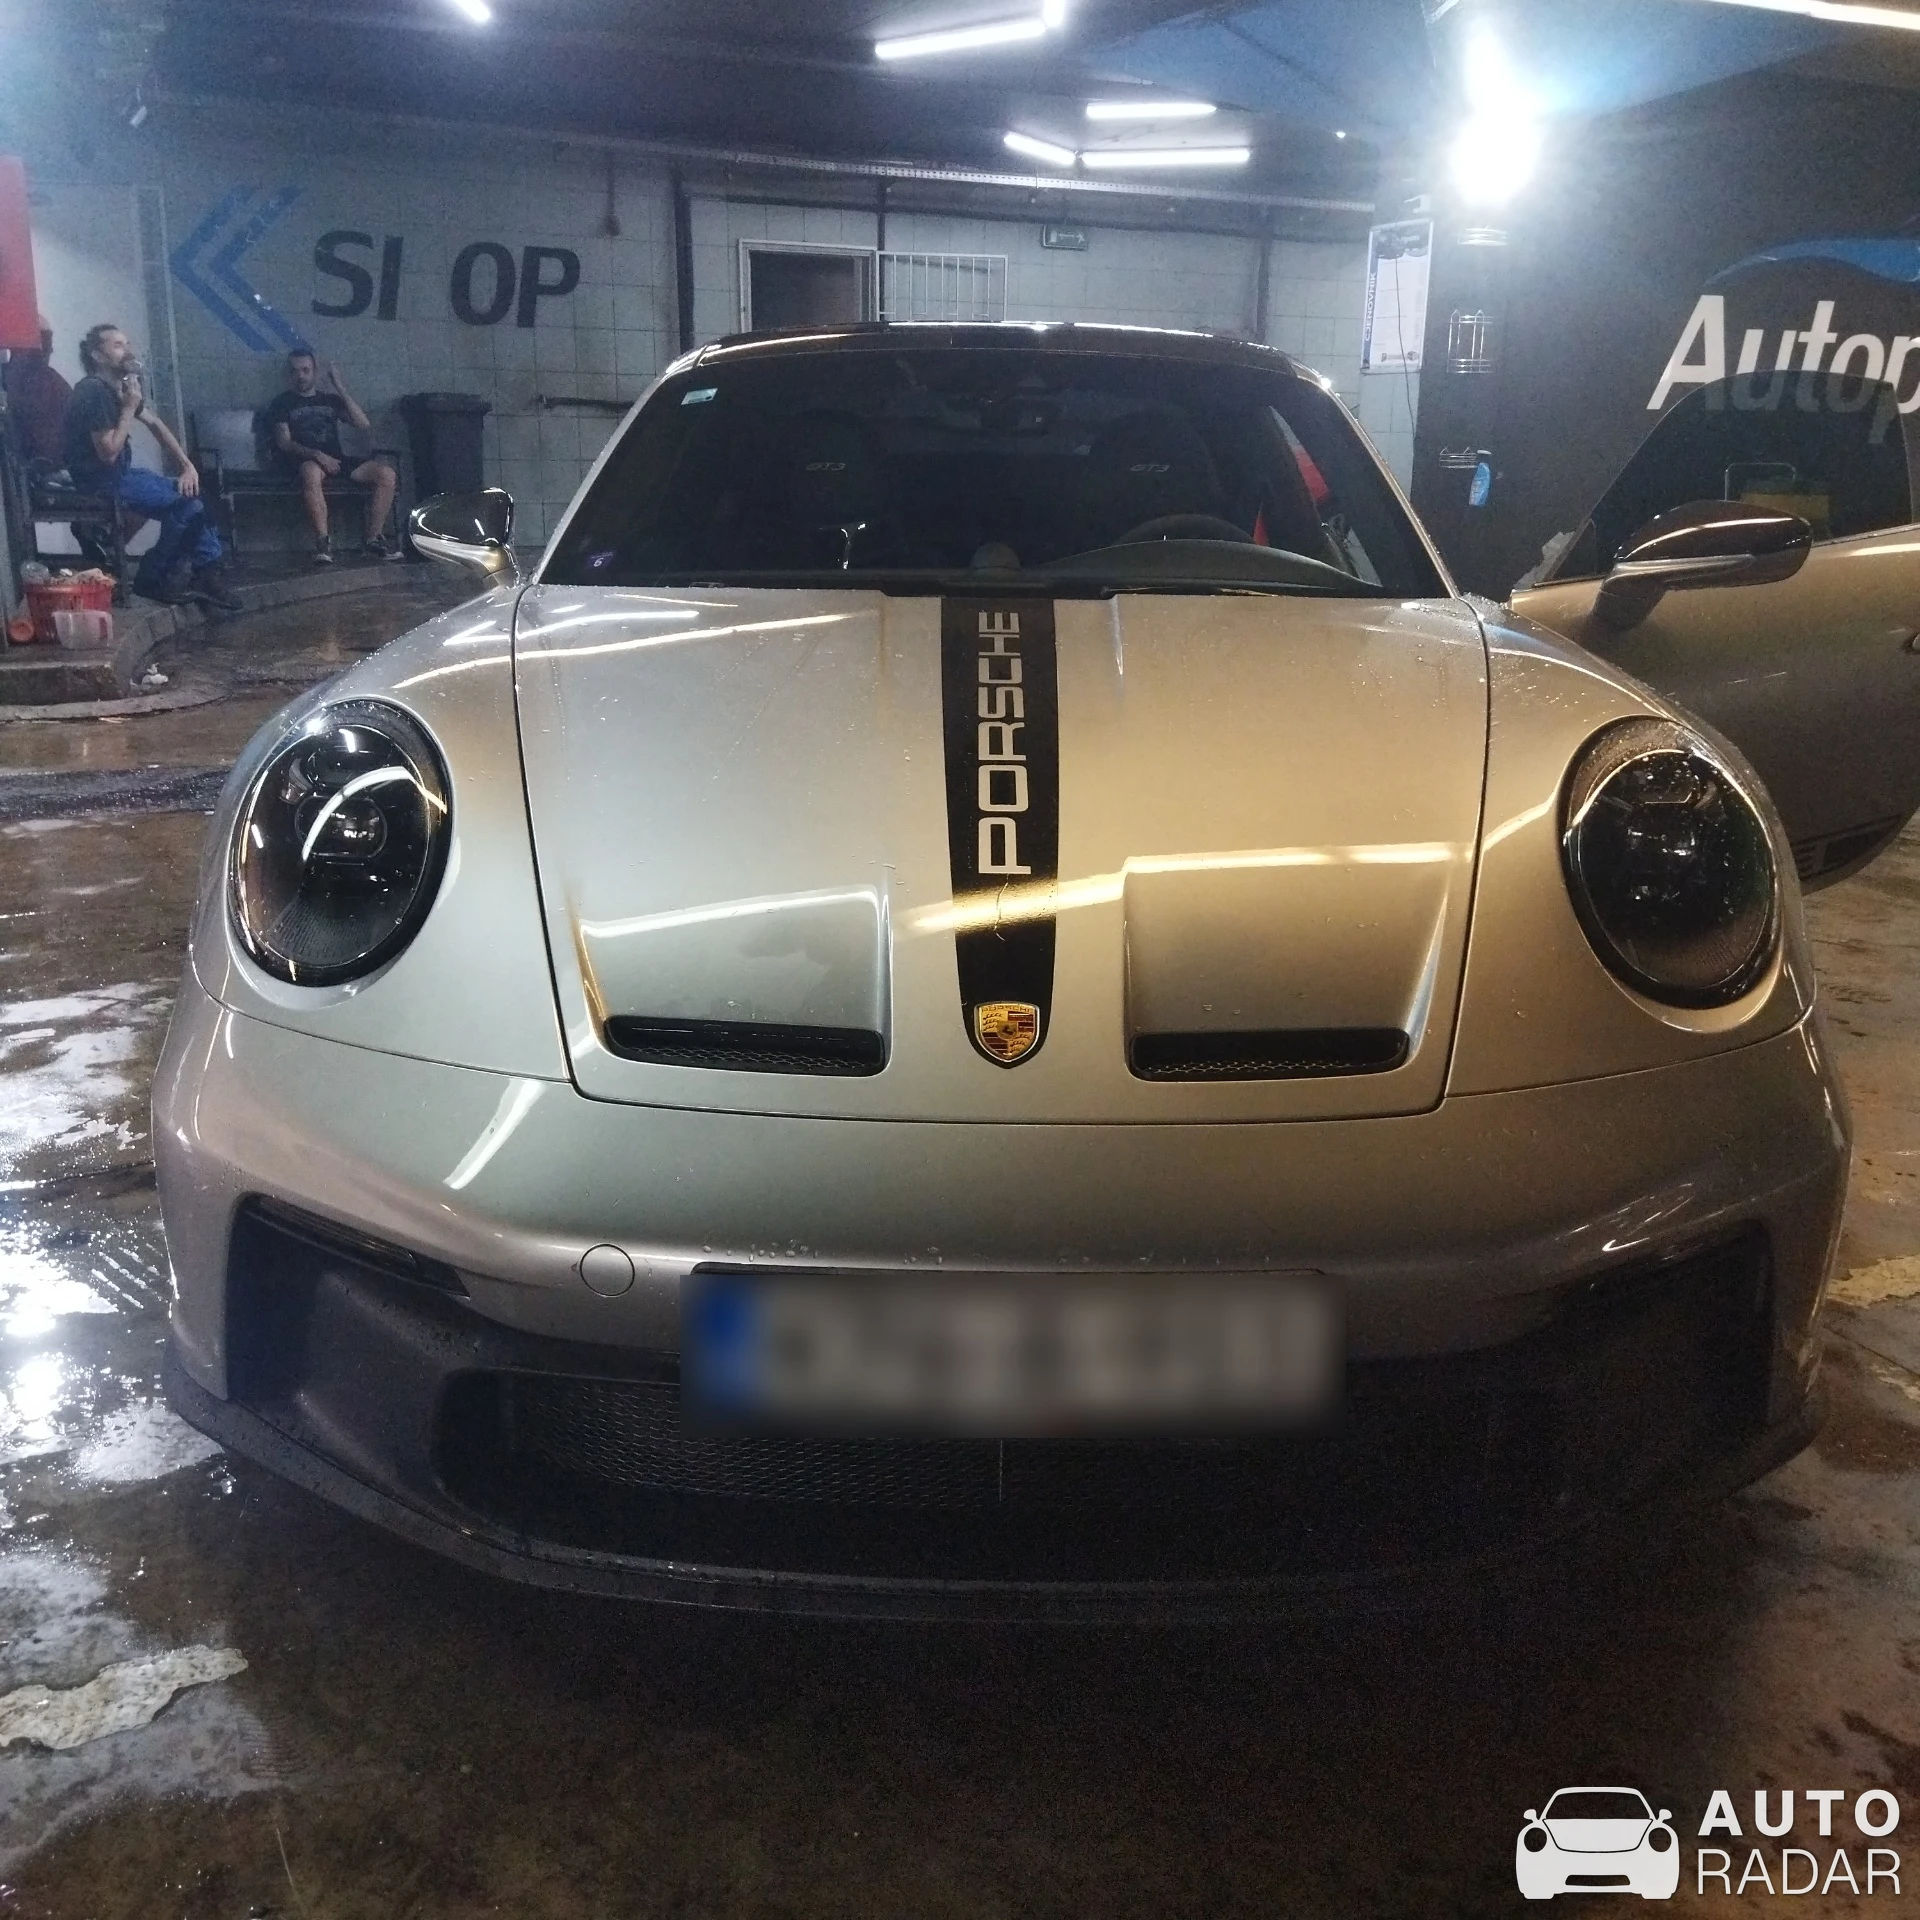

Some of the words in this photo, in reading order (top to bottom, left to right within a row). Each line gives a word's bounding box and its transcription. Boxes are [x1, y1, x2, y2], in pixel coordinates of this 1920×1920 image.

[1365, 272, 1376, 342] CJENOVNIK
[805, 461, 846, 472] GT3
[1129, 463, 1170, 473] GT3
[978, 612, 1031, 874] PORSCHE
